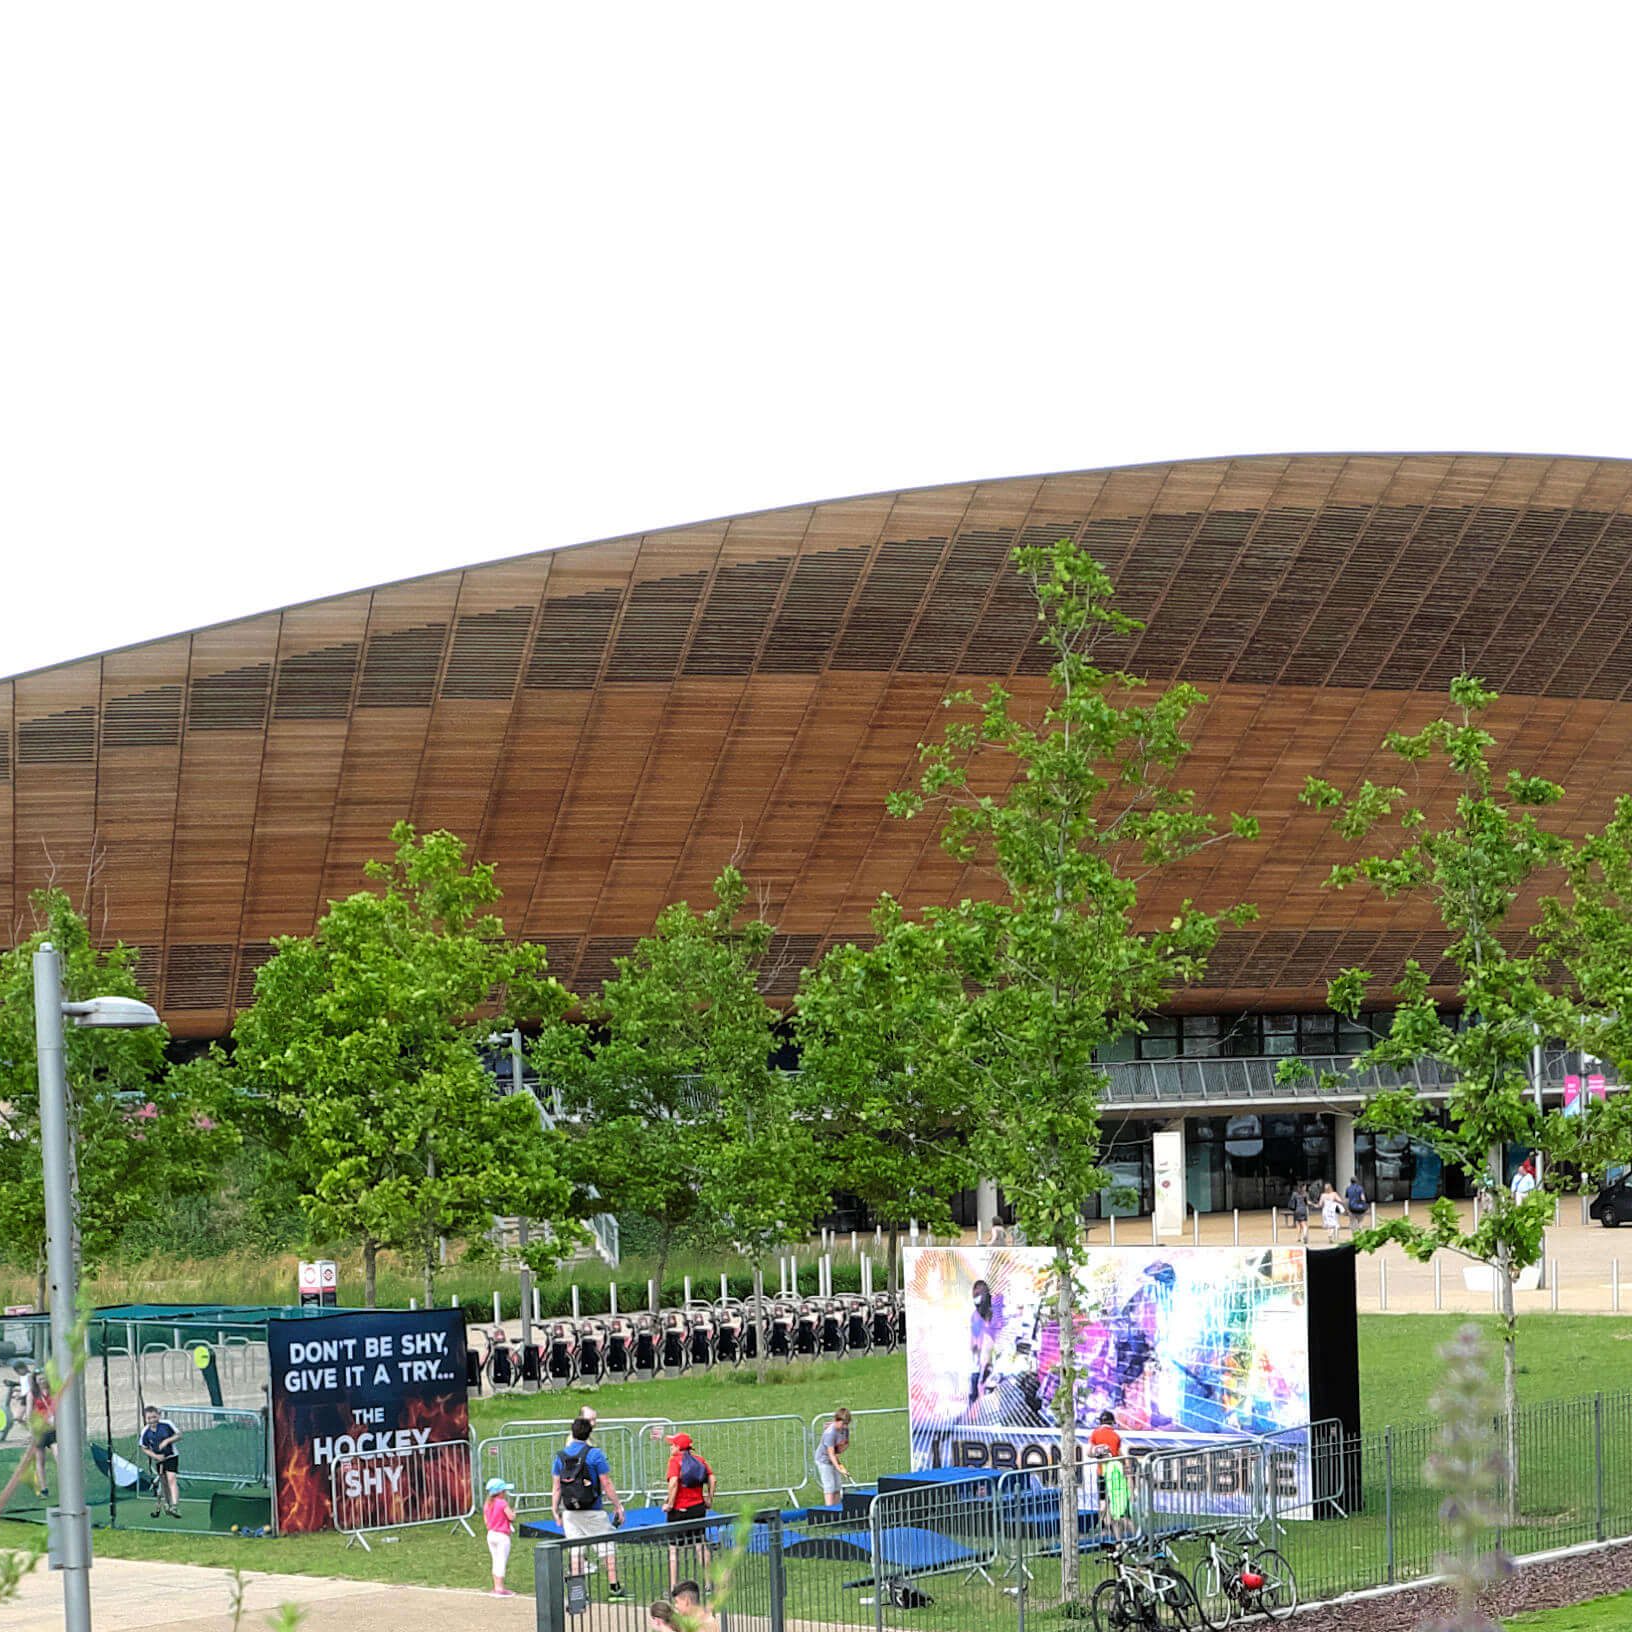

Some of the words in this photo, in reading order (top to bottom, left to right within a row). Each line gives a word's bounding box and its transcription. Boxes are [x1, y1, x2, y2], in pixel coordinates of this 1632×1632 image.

[289, 1338, 357, 1365] DON'T
[365, 1336, 393, 1359] BE
[401, 1332, 449, 1357] SHY,
[284, 1367, 338, 1393] GIVE
[345, 1366, 365, 1387] IT
[373, 1364, 391, 1386] A
[398, 1359, 455, 1383] TRY...
[352, 1407, 385, 1425] THE
[313, 1427, 432, 1466] HOCKEY
[345, 1465, 404, 1498] SHY
